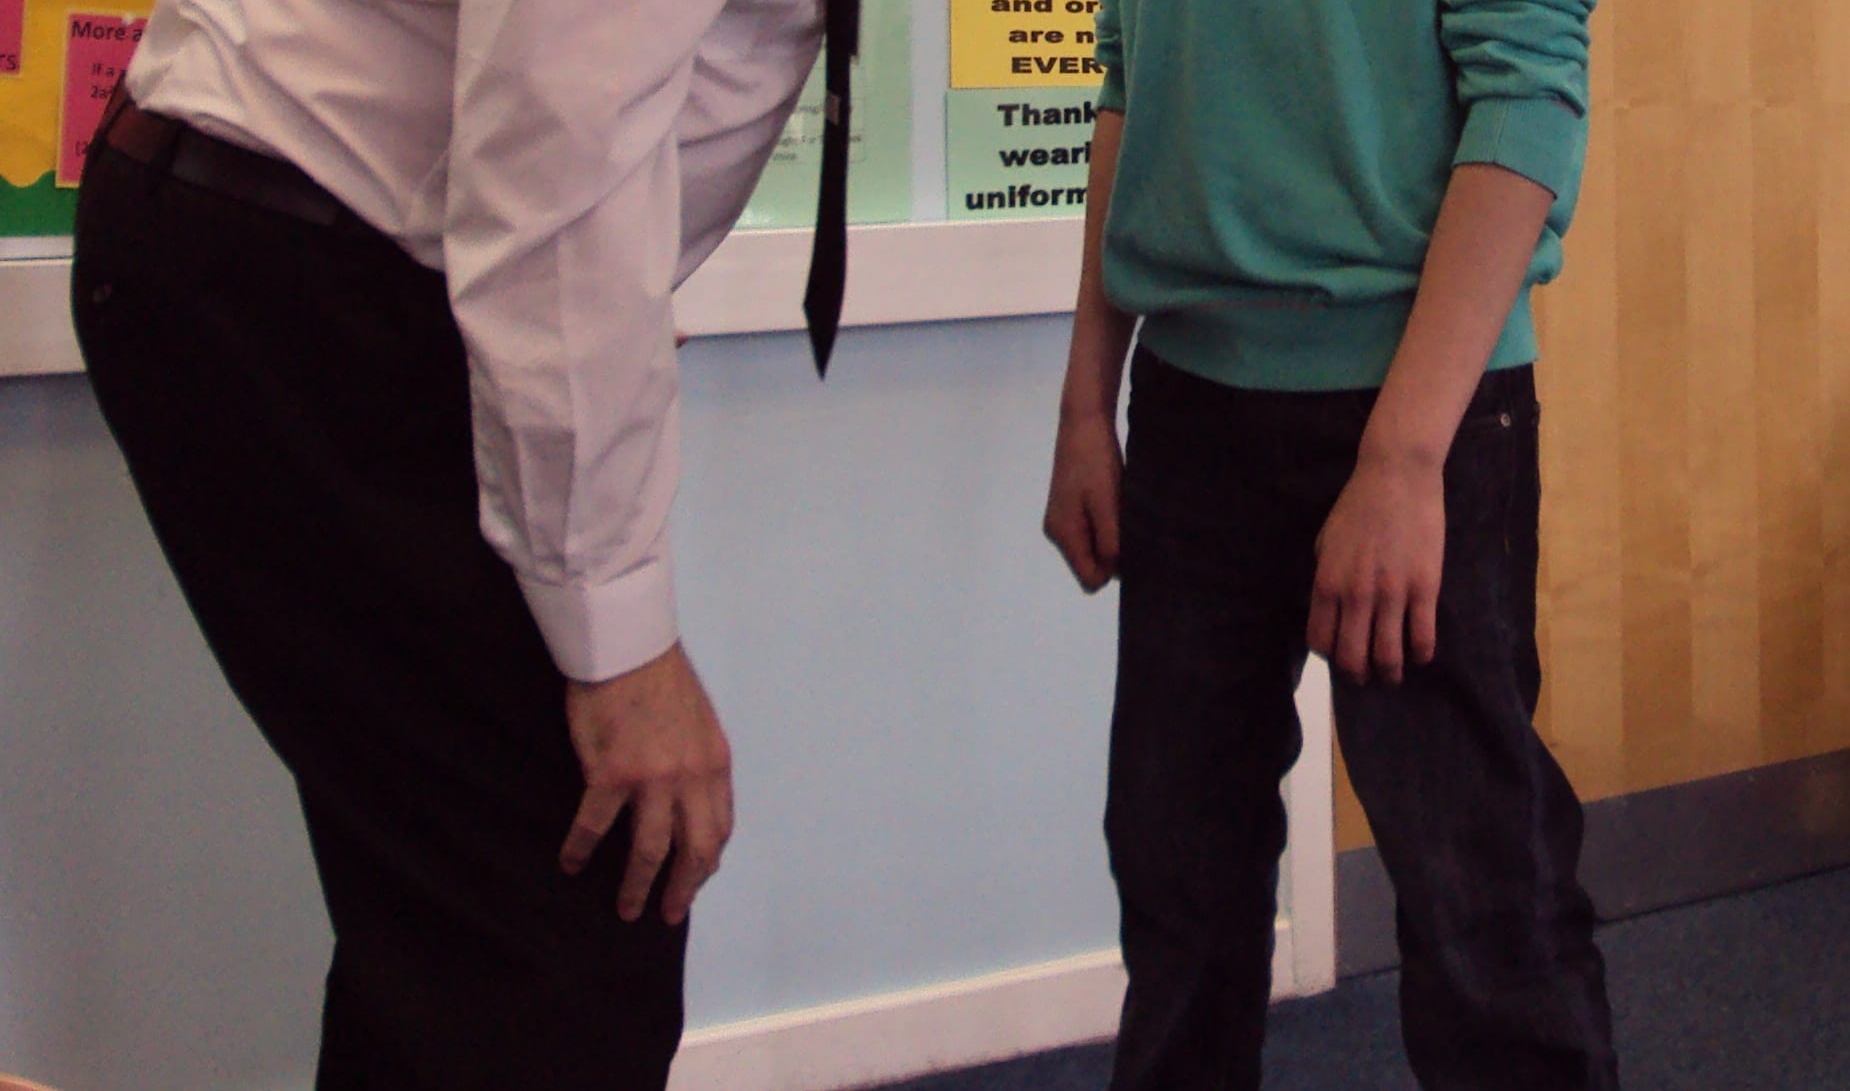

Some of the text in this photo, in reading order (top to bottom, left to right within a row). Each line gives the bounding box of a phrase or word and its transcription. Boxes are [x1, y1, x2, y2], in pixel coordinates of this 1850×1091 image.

[72, 21, 125, 41] More
[1009, 30, 1064, 43] are
[106, 67, 114, 77] a
[1011, 57, 1104, 74] EVER
[997, 101, 1097, 126] Thank
